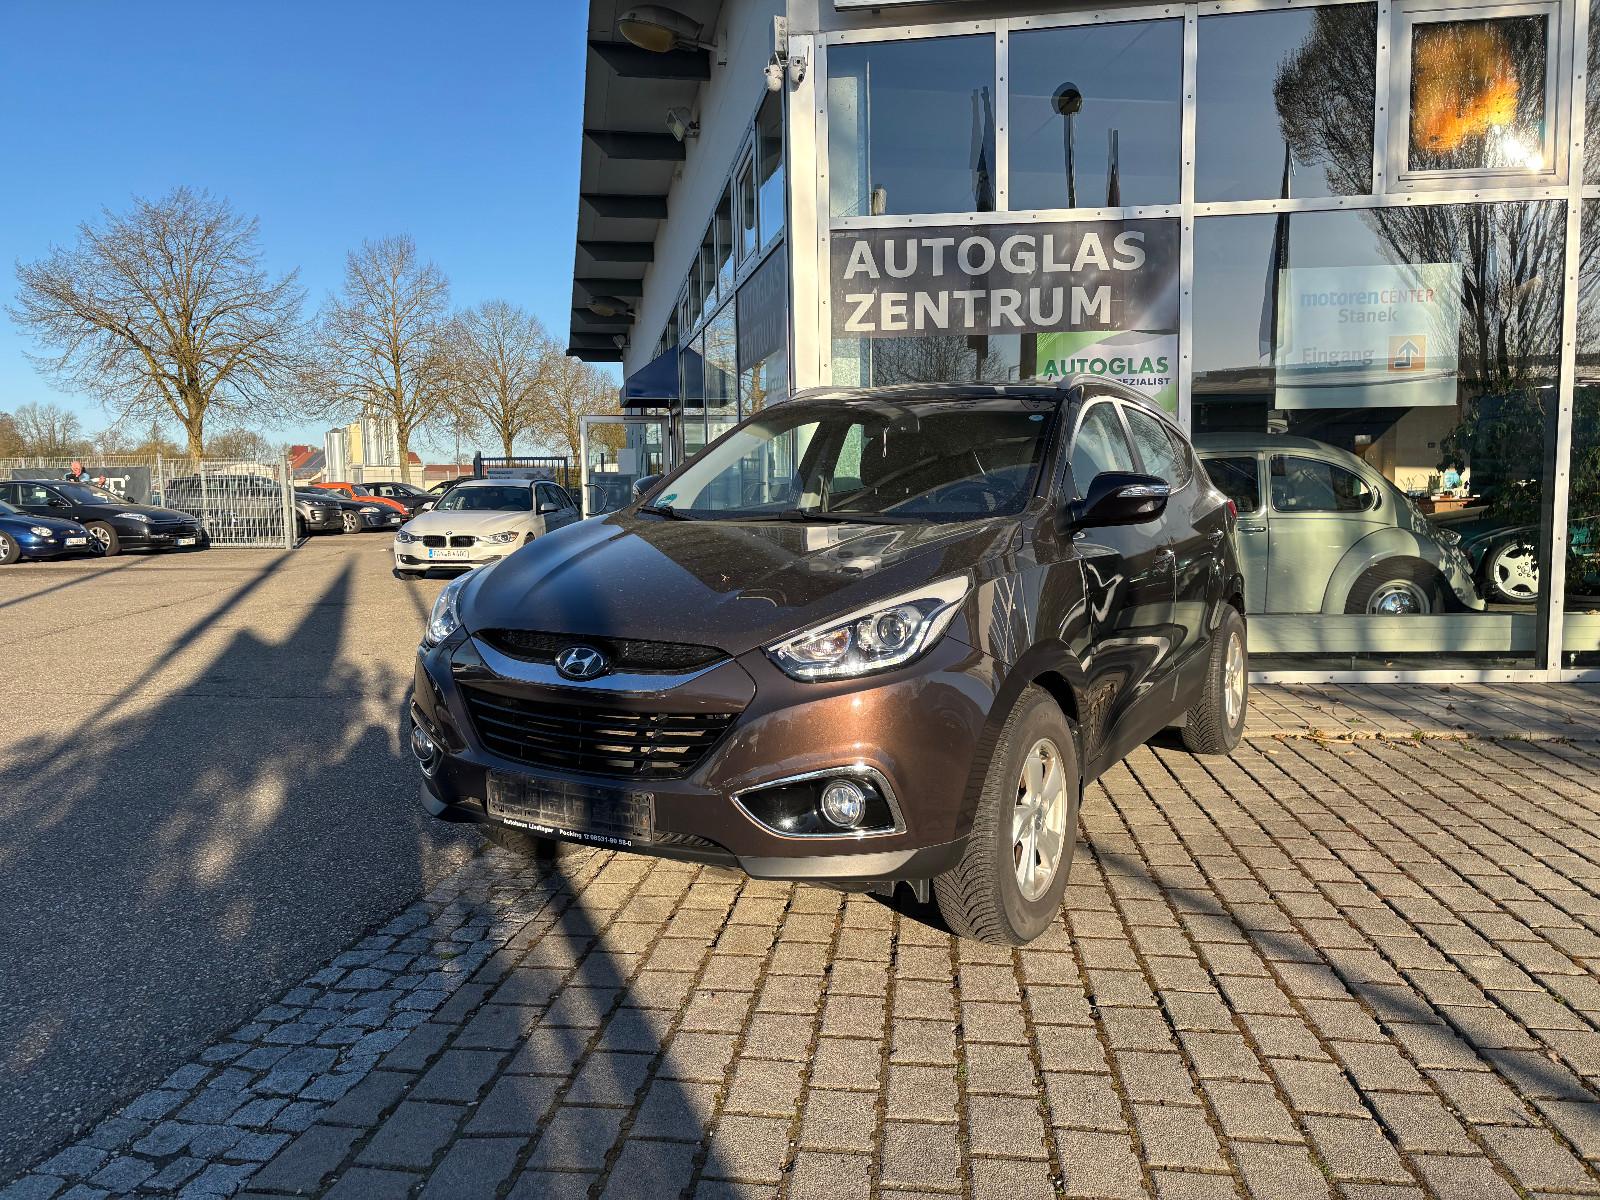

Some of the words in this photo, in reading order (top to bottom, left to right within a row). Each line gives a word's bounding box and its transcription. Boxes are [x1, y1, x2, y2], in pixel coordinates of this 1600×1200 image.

[843, 230, 1146, 279] AUTOGLAS
[844, 285, 1112, 332] ZENTRUM
[1338, 308, 1398, 323] Stanek
[1042, 356, 1169, 377] AUTOGLAS
[1302, 346, 1375, 366] Eingang
